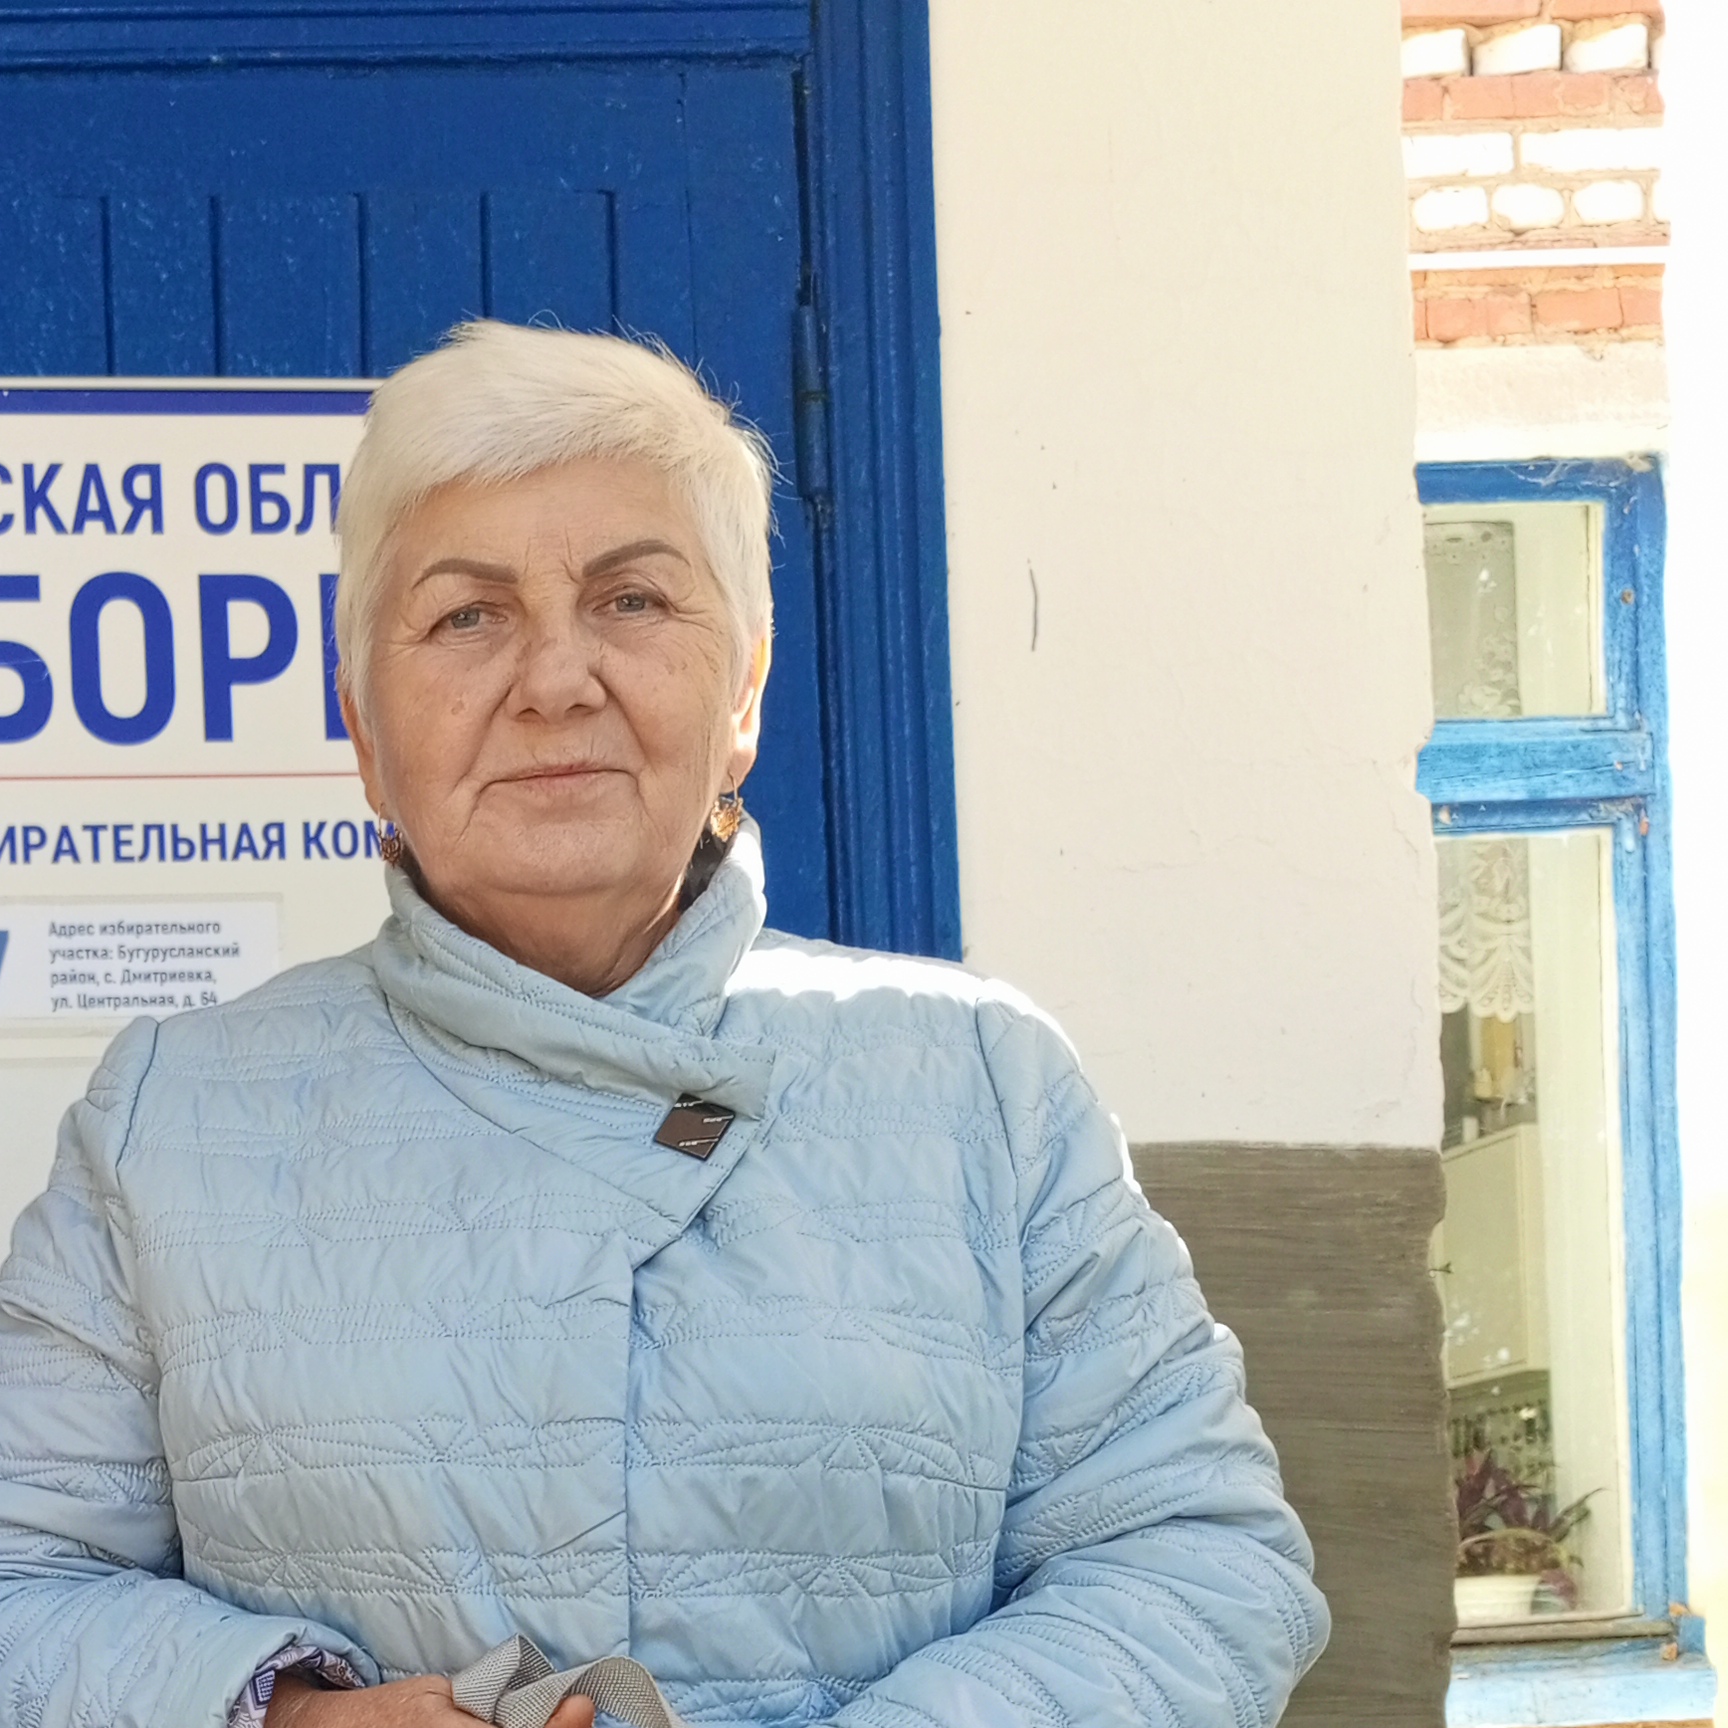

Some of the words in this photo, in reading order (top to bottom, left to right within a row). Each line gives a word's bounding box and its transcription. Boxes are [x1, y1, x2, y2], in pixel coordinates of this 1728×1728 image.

[192, 461, 341, 536] ОБЛ
[48, 921, 95, 940] Адрес
[99, 919, 221, 939] избирательного
[49, 947, 114, 965] участка:
[117, 942, 241, 963] Бугурусланский
[51, 969, 100, 987] район,
[104, 971, 116, 985] с.
[121, 968, 217, 986] Дмитриевка,
[51, 995, 73, 1013] ул.
[77, 992, 179, 1011] Центральная,
